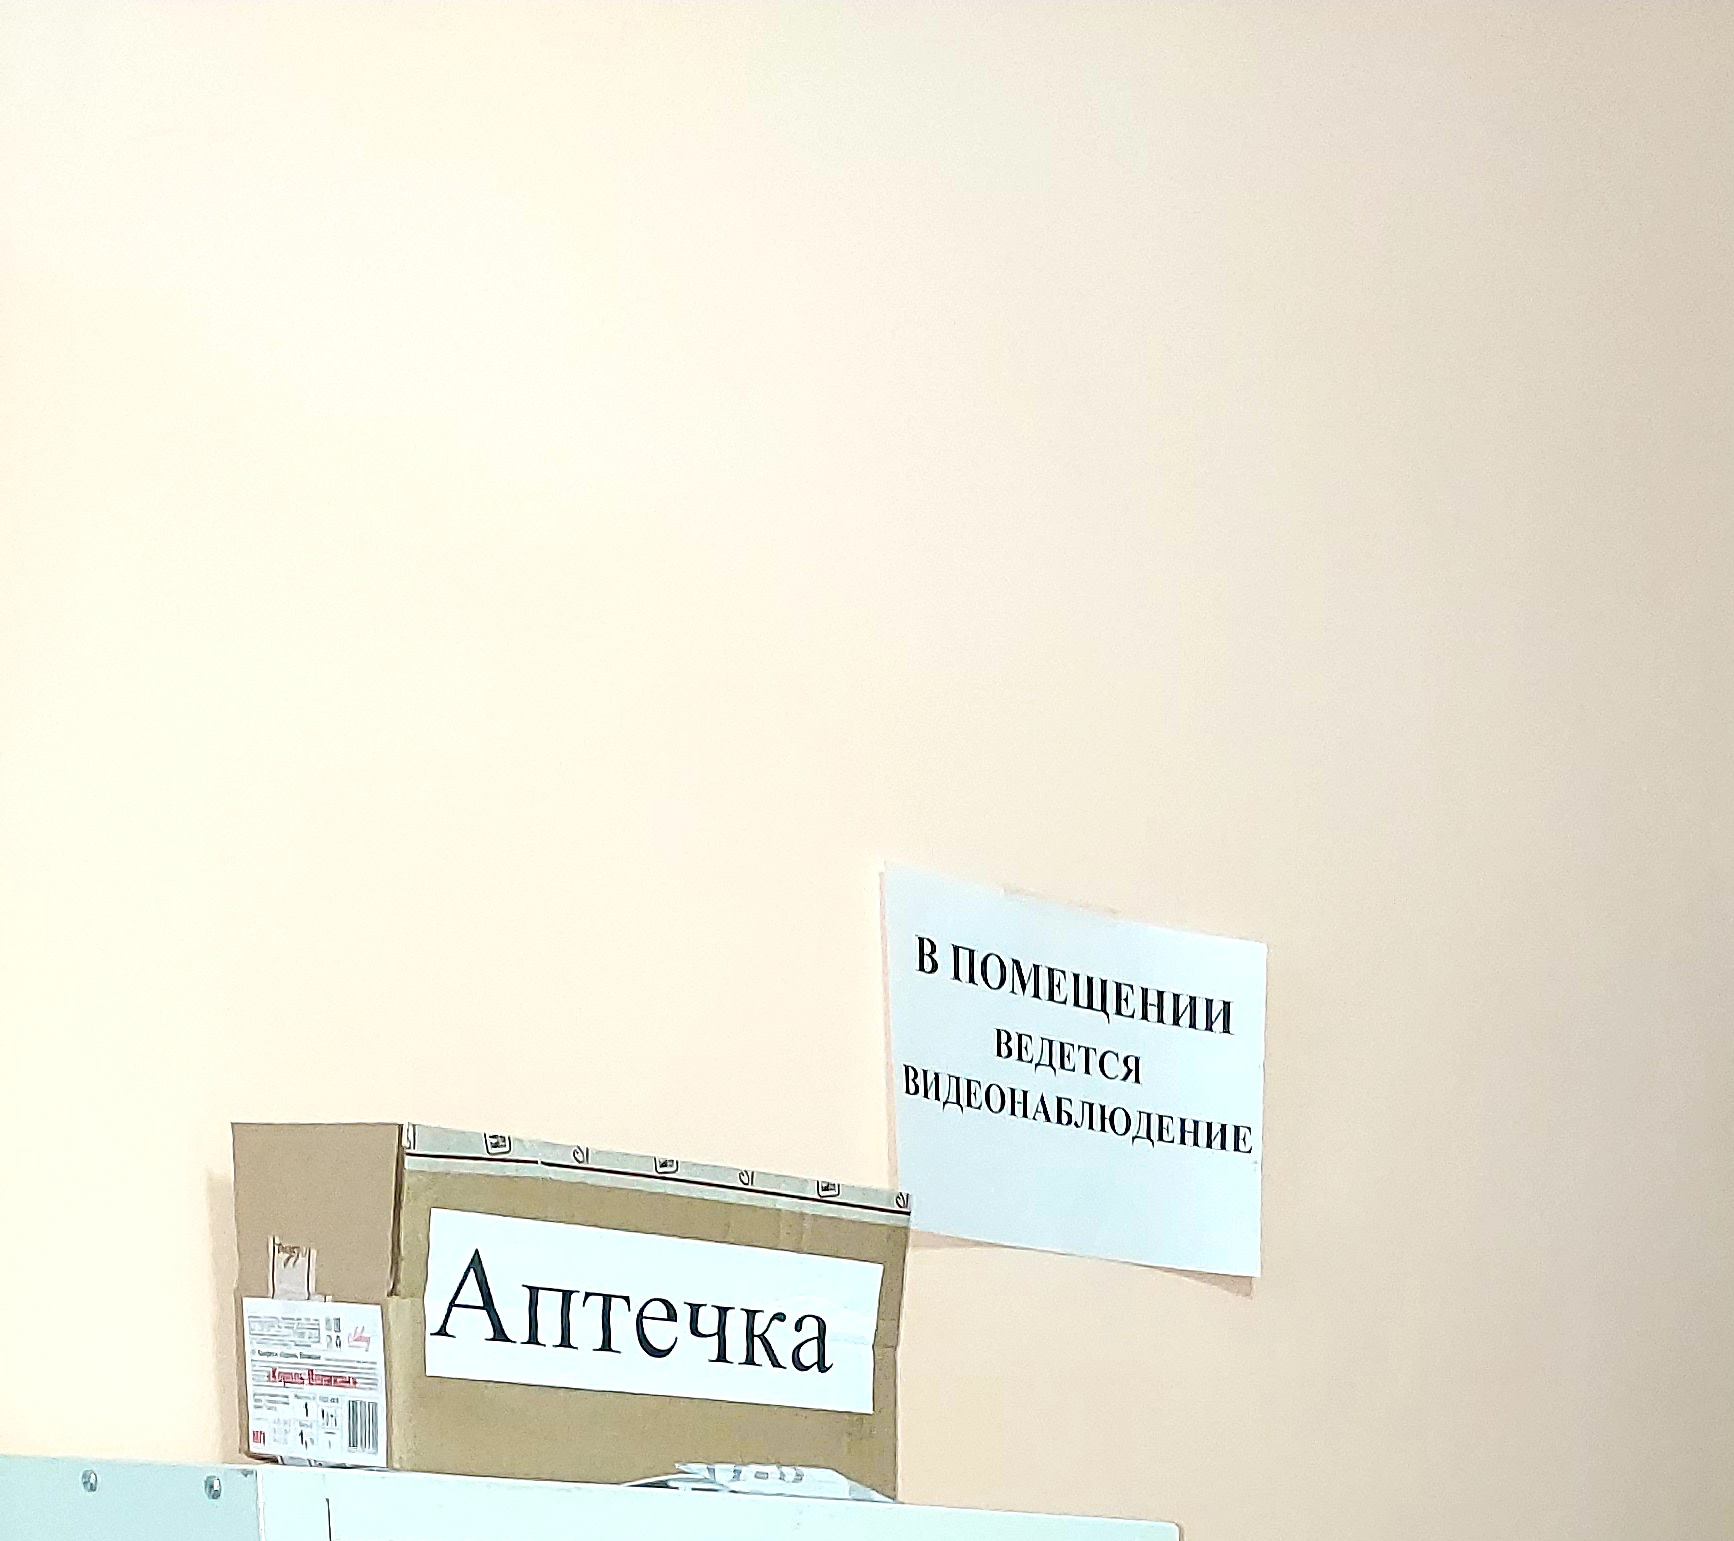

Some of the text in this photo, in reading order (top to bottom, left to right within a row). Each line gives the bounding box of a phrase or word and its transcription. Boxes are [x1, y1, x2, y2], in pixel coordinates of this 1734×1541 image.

[915, 934, 1235, 1036] В ПОМЕЩЕНИИ
[994, 1027, 1143, 1086] ВЕДЕТСЯ
[902, 1063, 1254, 1155] ВИДЕОНАБЛЮДЕНИЕ
[430, 1247, 834, 1375] Аптечка
